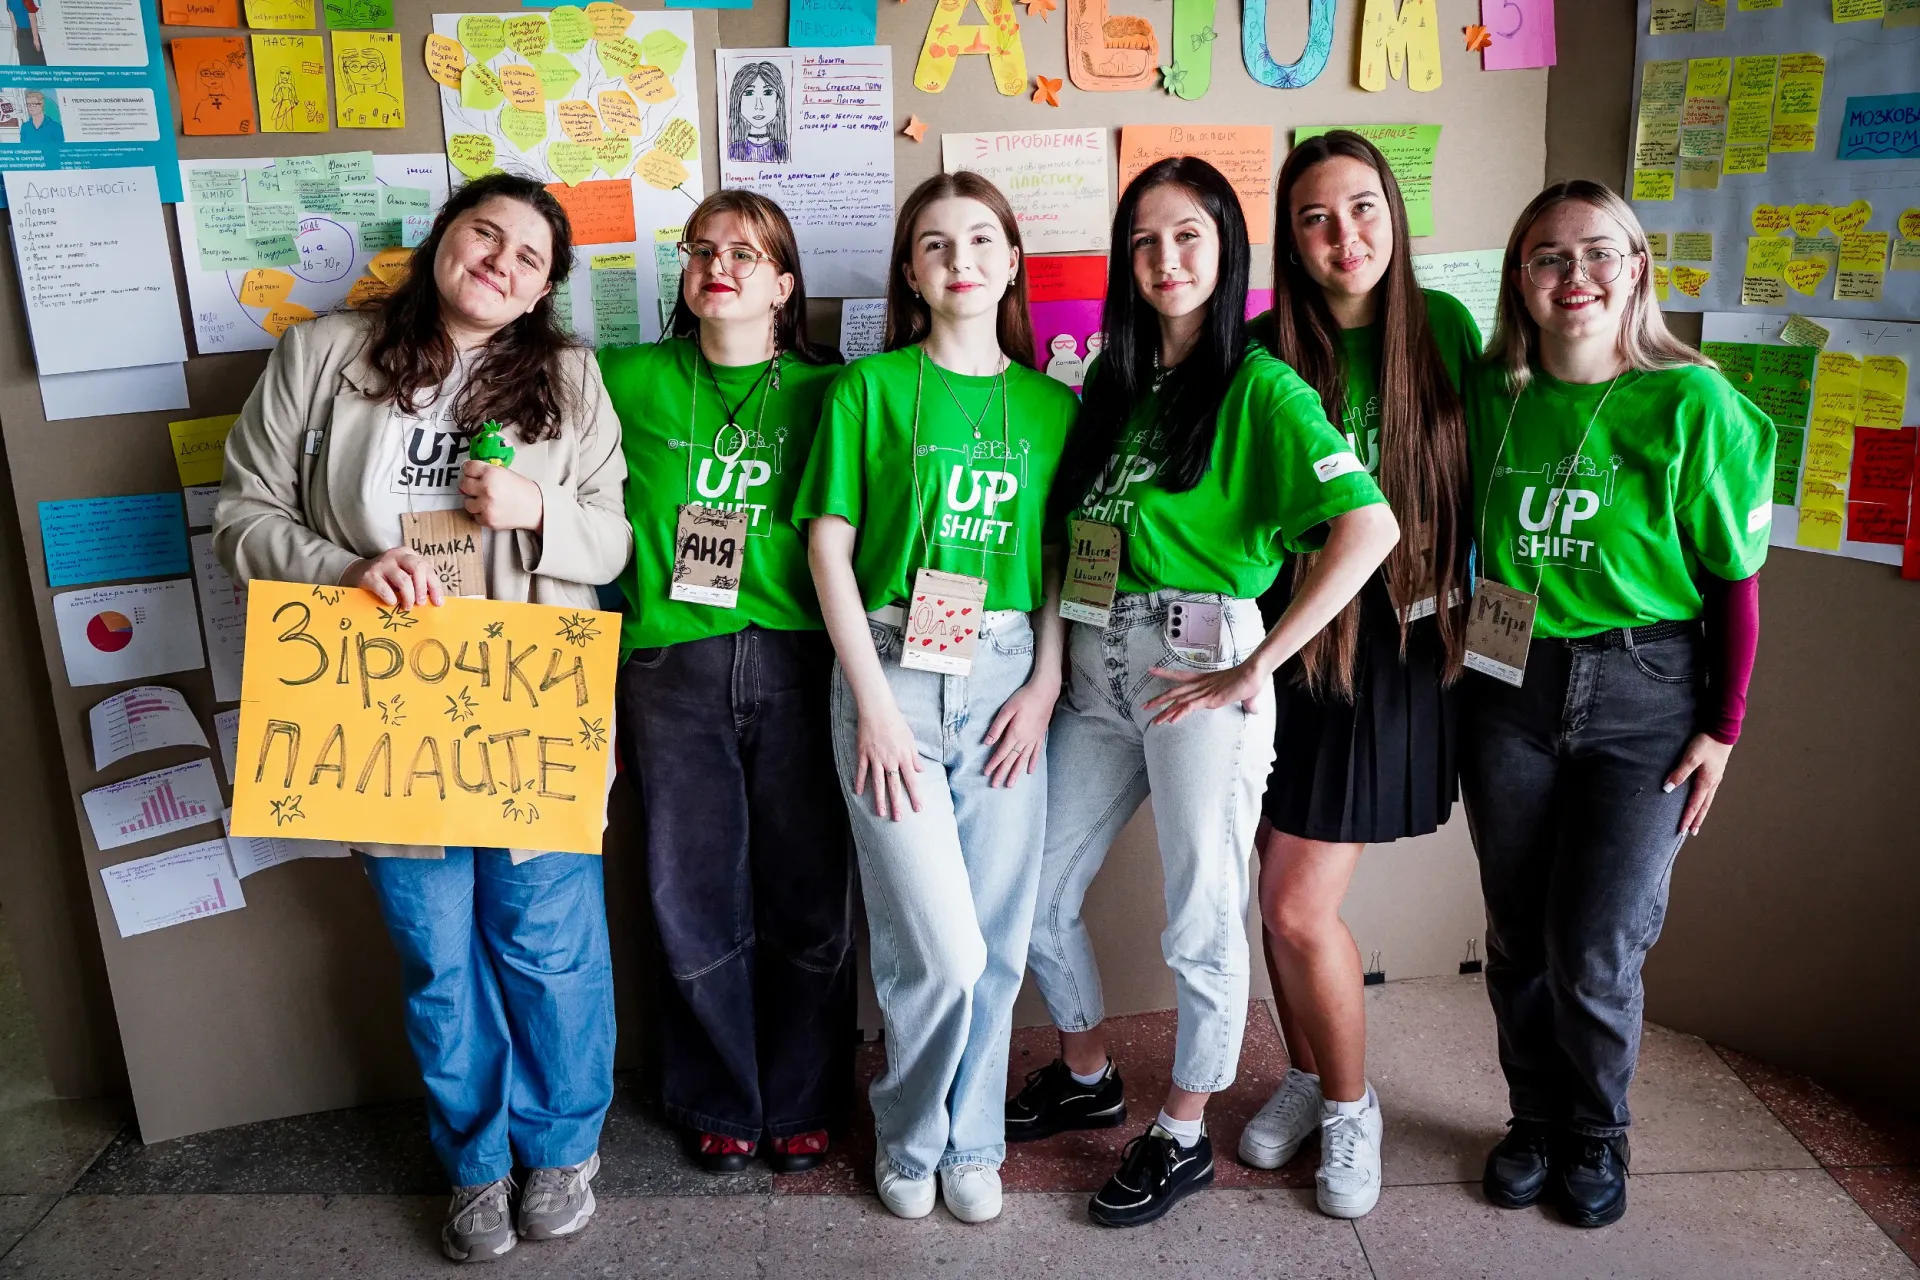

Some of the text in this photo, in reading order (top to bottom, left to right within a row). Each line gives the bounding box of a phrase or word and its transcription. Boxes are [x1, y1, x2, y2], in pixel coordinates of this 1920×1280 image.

[263, 37, 305, 47] НАСТЯ
[995, 133, 1083, 152] ПРОБЛЕМА
[1848, 130, 1917, 147] ШТОРМ
[398, 466, 461, 487] SHIF
[696, 458, 771, 500] UP
[947, 464, 1018, 516] UP
[1094, 454, 1157, 497] UP
[1082, 494, 1135, 524] SHIFT
[1518, 486, 1600, 535] UP
[939, 513, 1013, 545] SHIFT
[681, 533, 735, 569] АНЯ
[1517, 534, 1595, 563] SHIFT
[913, 602, 961, 637] Оля
[255, 719, 577, 802] ПАЛАЙТЕ
